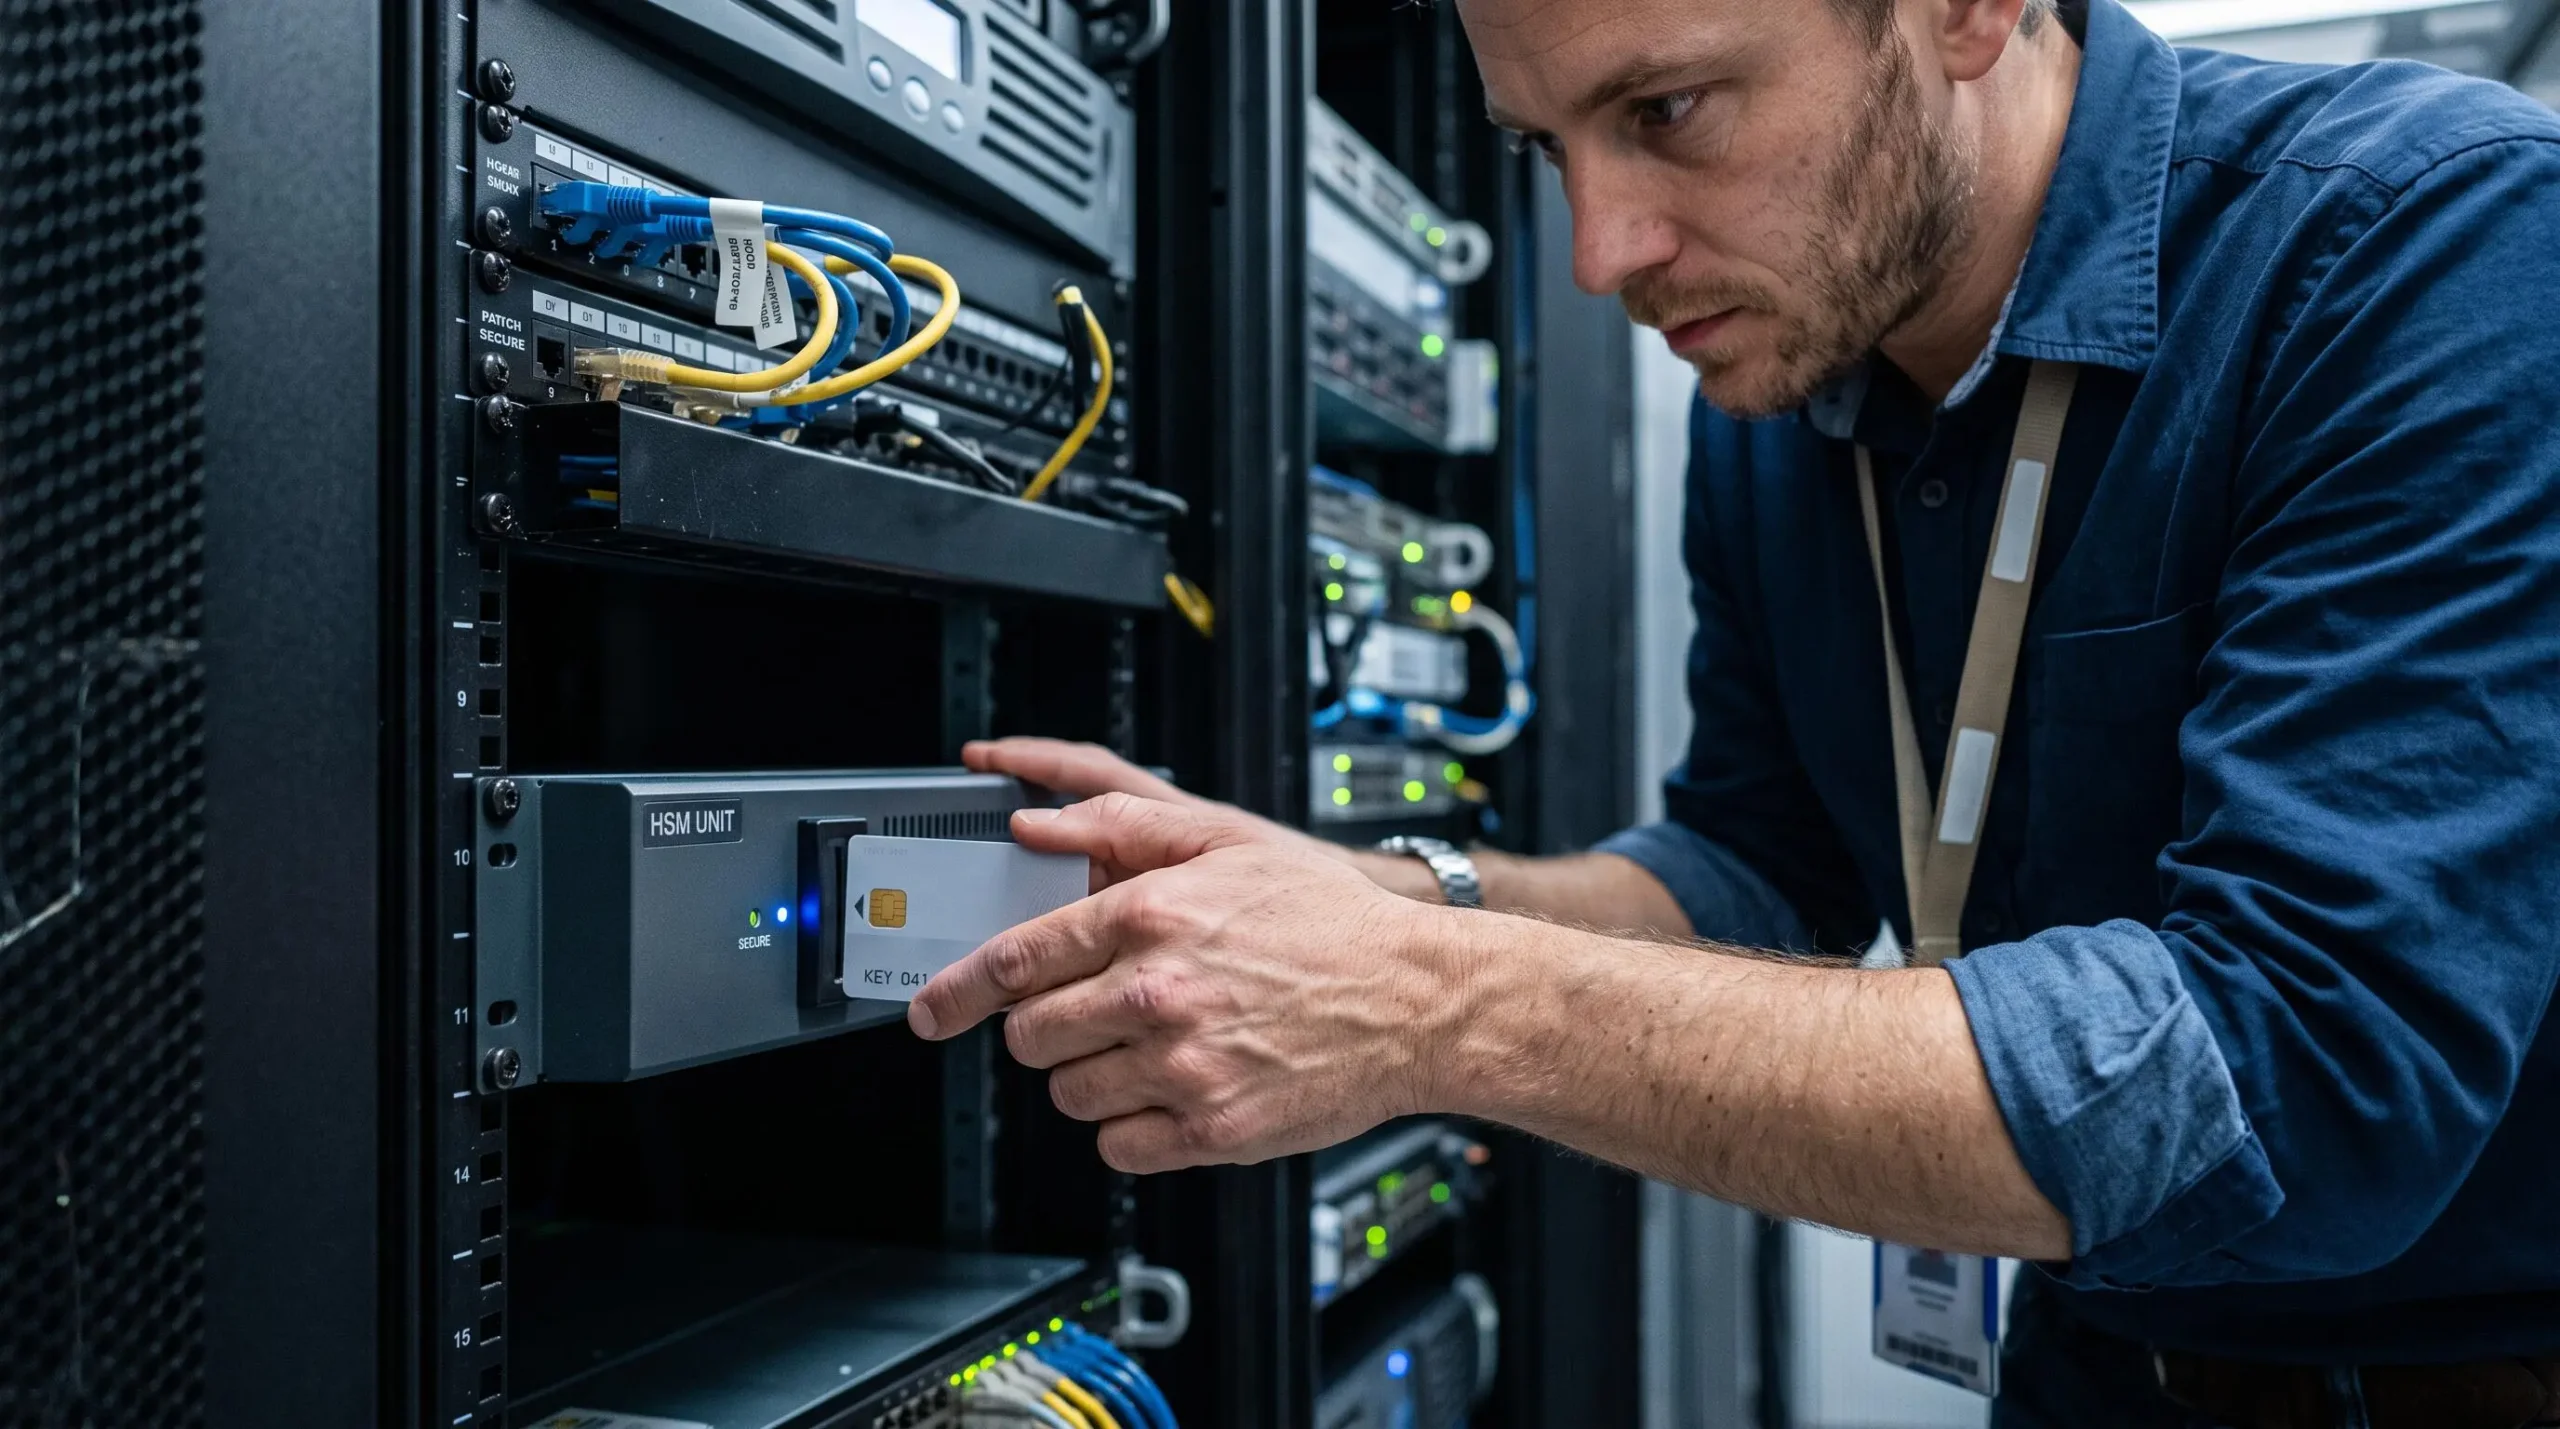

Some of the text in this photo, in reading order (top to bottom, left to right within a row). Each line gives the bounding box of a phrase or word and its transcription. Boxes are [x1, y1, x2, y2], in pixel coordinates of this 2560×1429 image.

[550, 239, 558, 251] 1
[588, 251, 596, 265] 2
[481, 309, 523, 333] PATTCH
[479, 327, 527, 352] SECURE
[548, 386, 556, 399] 9
[457, 690, 467, 707] 9
[650, 809, 736, 837] HSM UNIT
[453, 848, 470, 866] 10
[738, 934, 772, 950] SECURE
[864, 969, 928, 986] KEY 041
[454, 1007, 469, 1025] 11
[453, 1165, 471, 1185] 14
[453, 1328, 471, 1348] 15
